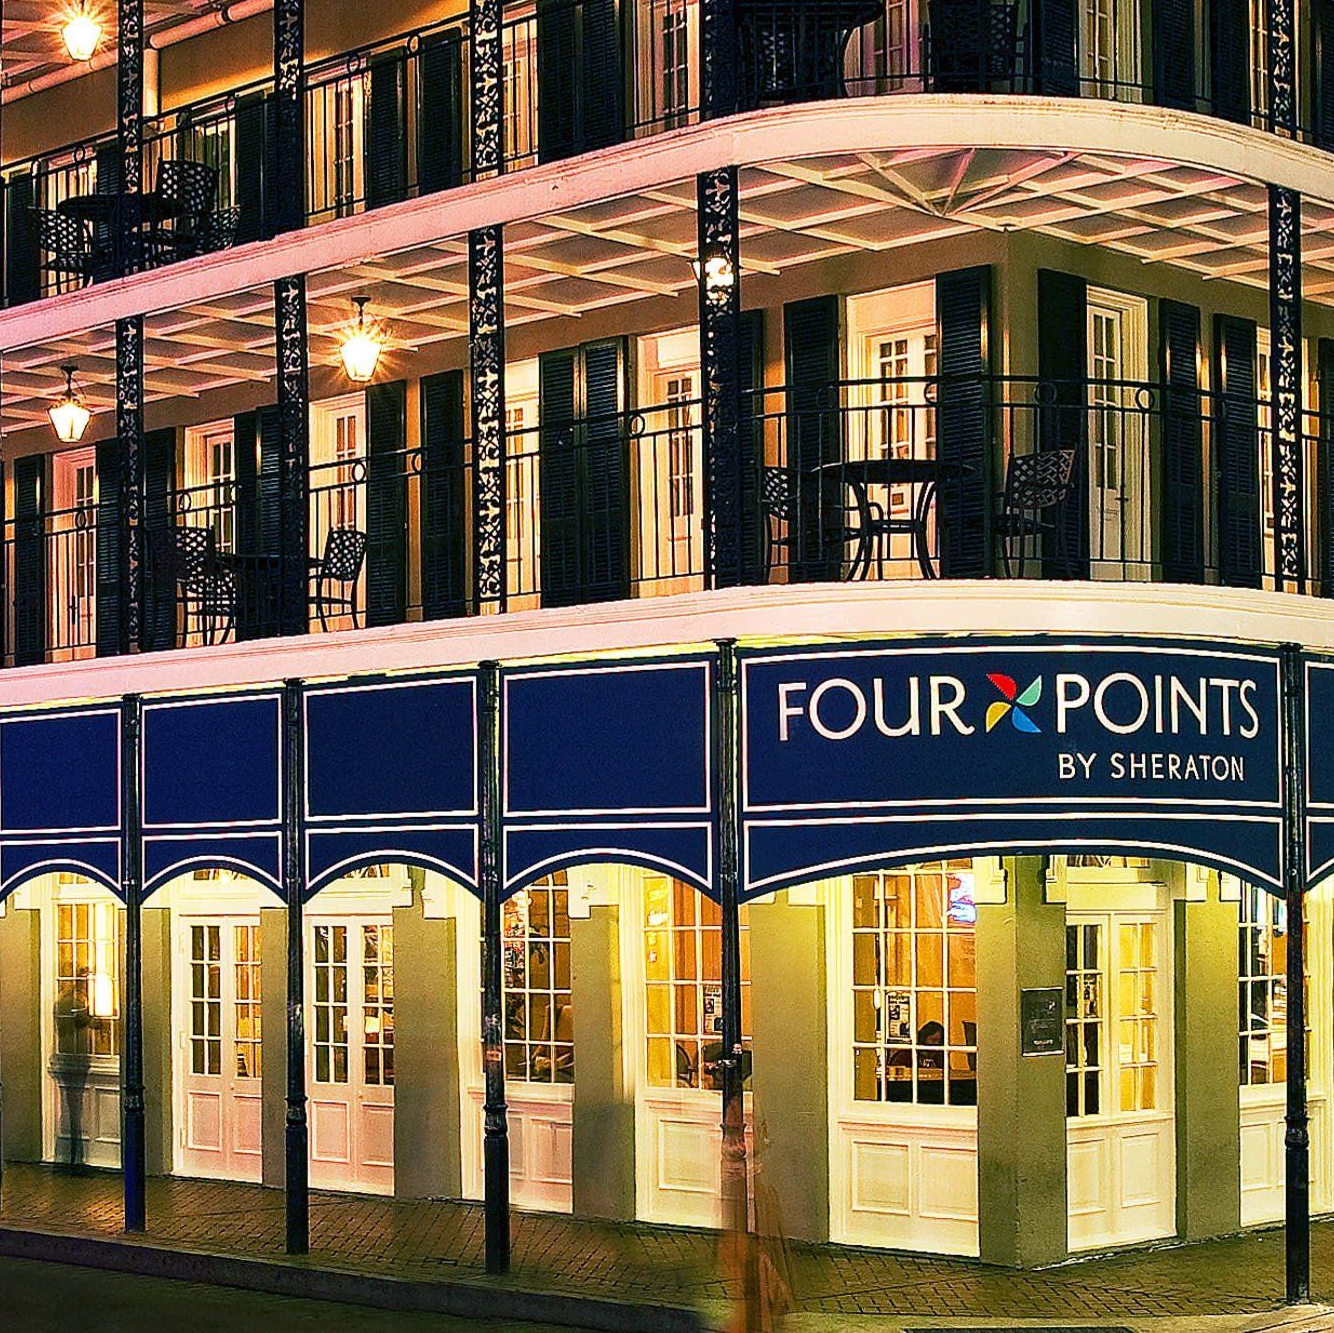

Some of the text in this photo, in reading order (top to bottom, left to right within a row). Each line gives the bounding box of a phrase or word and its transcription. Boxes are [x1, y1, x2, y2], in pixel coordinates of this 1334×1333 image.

[778, 672, 1260, 741] FOUR POINTS
[1058, 752, 1245, 781] BY SHERATON
